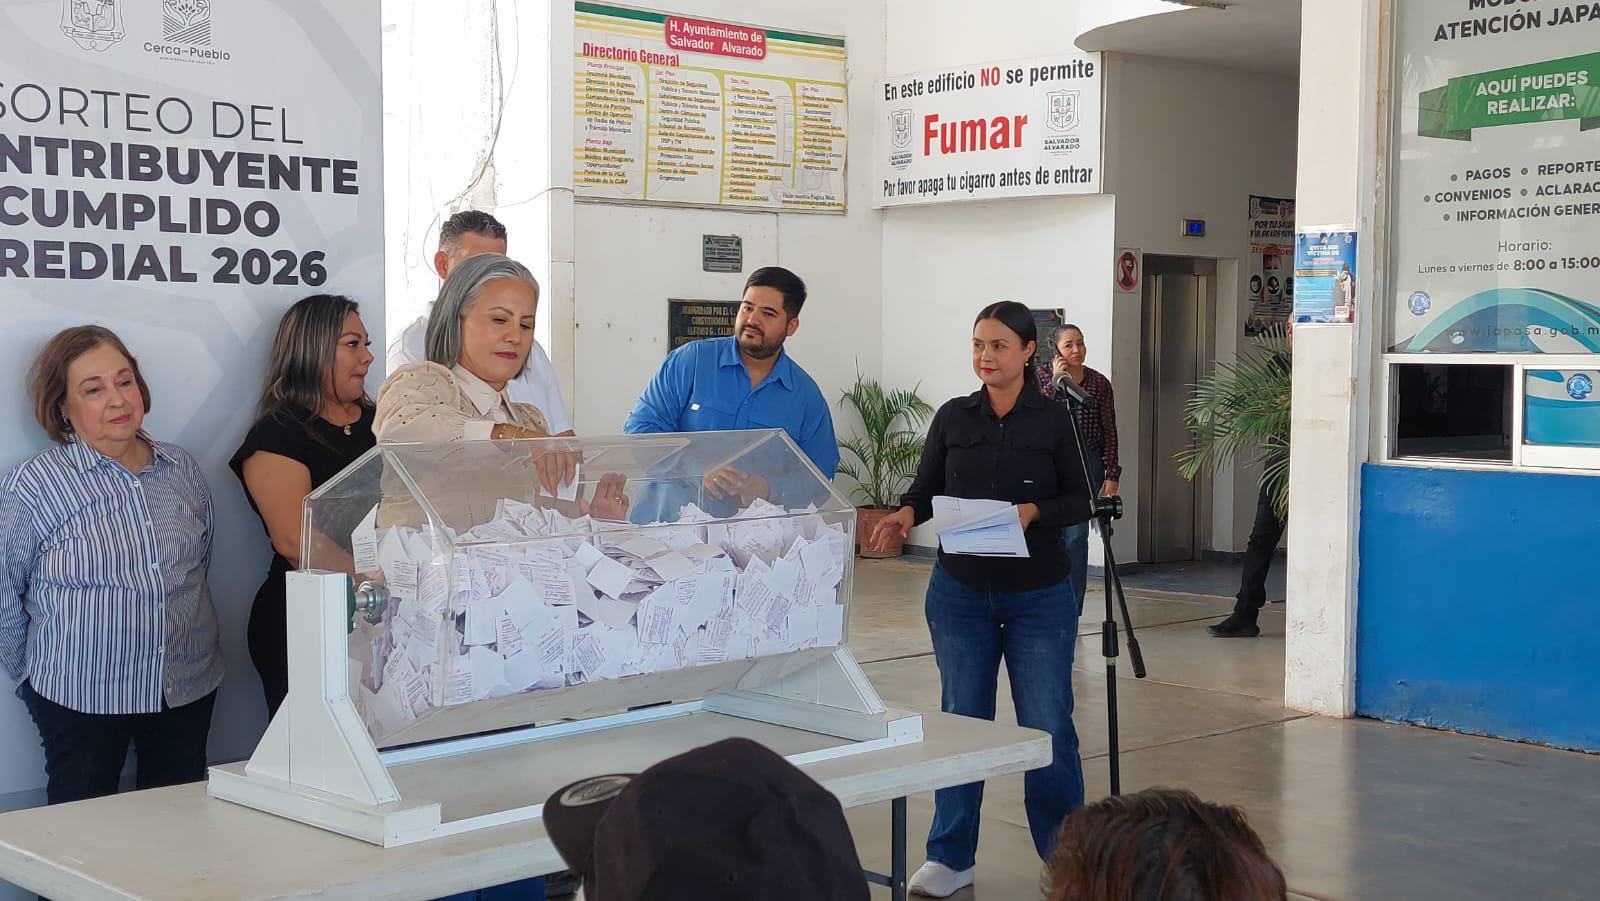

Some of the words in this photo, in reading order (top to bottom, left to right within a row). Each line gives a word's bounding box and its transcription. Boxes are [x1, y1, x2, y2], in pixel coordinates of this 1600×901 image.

[670, 20, 680, 32] H.
[683, 22, 749, 41] Ayuntamiento
[751, 32, 762, 43] de
[1434, 9, 1541, 42] ATENCIÓN
[1547, 3, 1600, 26] JAPA
[144, 42, 181, 55] Cerca
[190, 46, 231, 61] Pueblo
[583, 42, 637, 62] Directorio
[640, 49, 680, 67] General
[670, 35, 714, 50] Salvador
[722, 41, 763, 56] Alvarado
[884, 83, 898, 101] En
[901, 79, 924, 98] este
[927, 71, 975, 94] edificio
[980, 66, 1000, 87] NO
[1006, 69, 1023, 84] se
[1029, 59, 1094, 86] permite
[1476, 75, 1517, 97] AQUÍ
[1521, 70, 1589, 92] PUEDES
[0, 82, 193, 135] ORTEO
[212, 101, 304, 145] DEL
[1487, 93, 1576, 115] REALIZAR:
[924, 113, 1028, 156] Fumar
[0, 133, 359, 195] NTRIBUYENTE
[1465, 167, 1511, 181] PAGOS
[1538, 160, 1600, 176] REPORTE
[884, 179, 895, 197] Por
[897, 177, 916, 197] favor
[918, 177, 944, 197] apaga
[947, 173, 956, 191] tu
[959, 171, 996, 193] cigarro
[999, 167, 1031, 187] antes
[1035, 166, 1050, 185] de
[1054, 165, 1093, 184] entrar
[1434, 188, 1512, 203] CONVENIOS
[1535, 181, 1600, 197] ACLARAC
[0, 185, 281, 238] CUMPLIDO
[1456, 204, 1550, 222] INFORMACIÓN
[1554, 202, 1600, 216] GENER
[1498, 238, 1552, 253] Horario:
[0, 238, 198, 284] REDIAL
[211, 247, 328, 287] 2026
[1418, 264, 1447, 274] Lunes
[1449, 265, 1456, 273] a
[1458, 262, 1494, 272] viernes
[1497, 262, 1509, 271] de
[1513, 259, 1546, 271] 8:00
[1549, 261, 1557, 270] a
[1561, 256, 1600, 269] 15:00
[1445, 324, 1599, 338] w.japasa.gob.m
